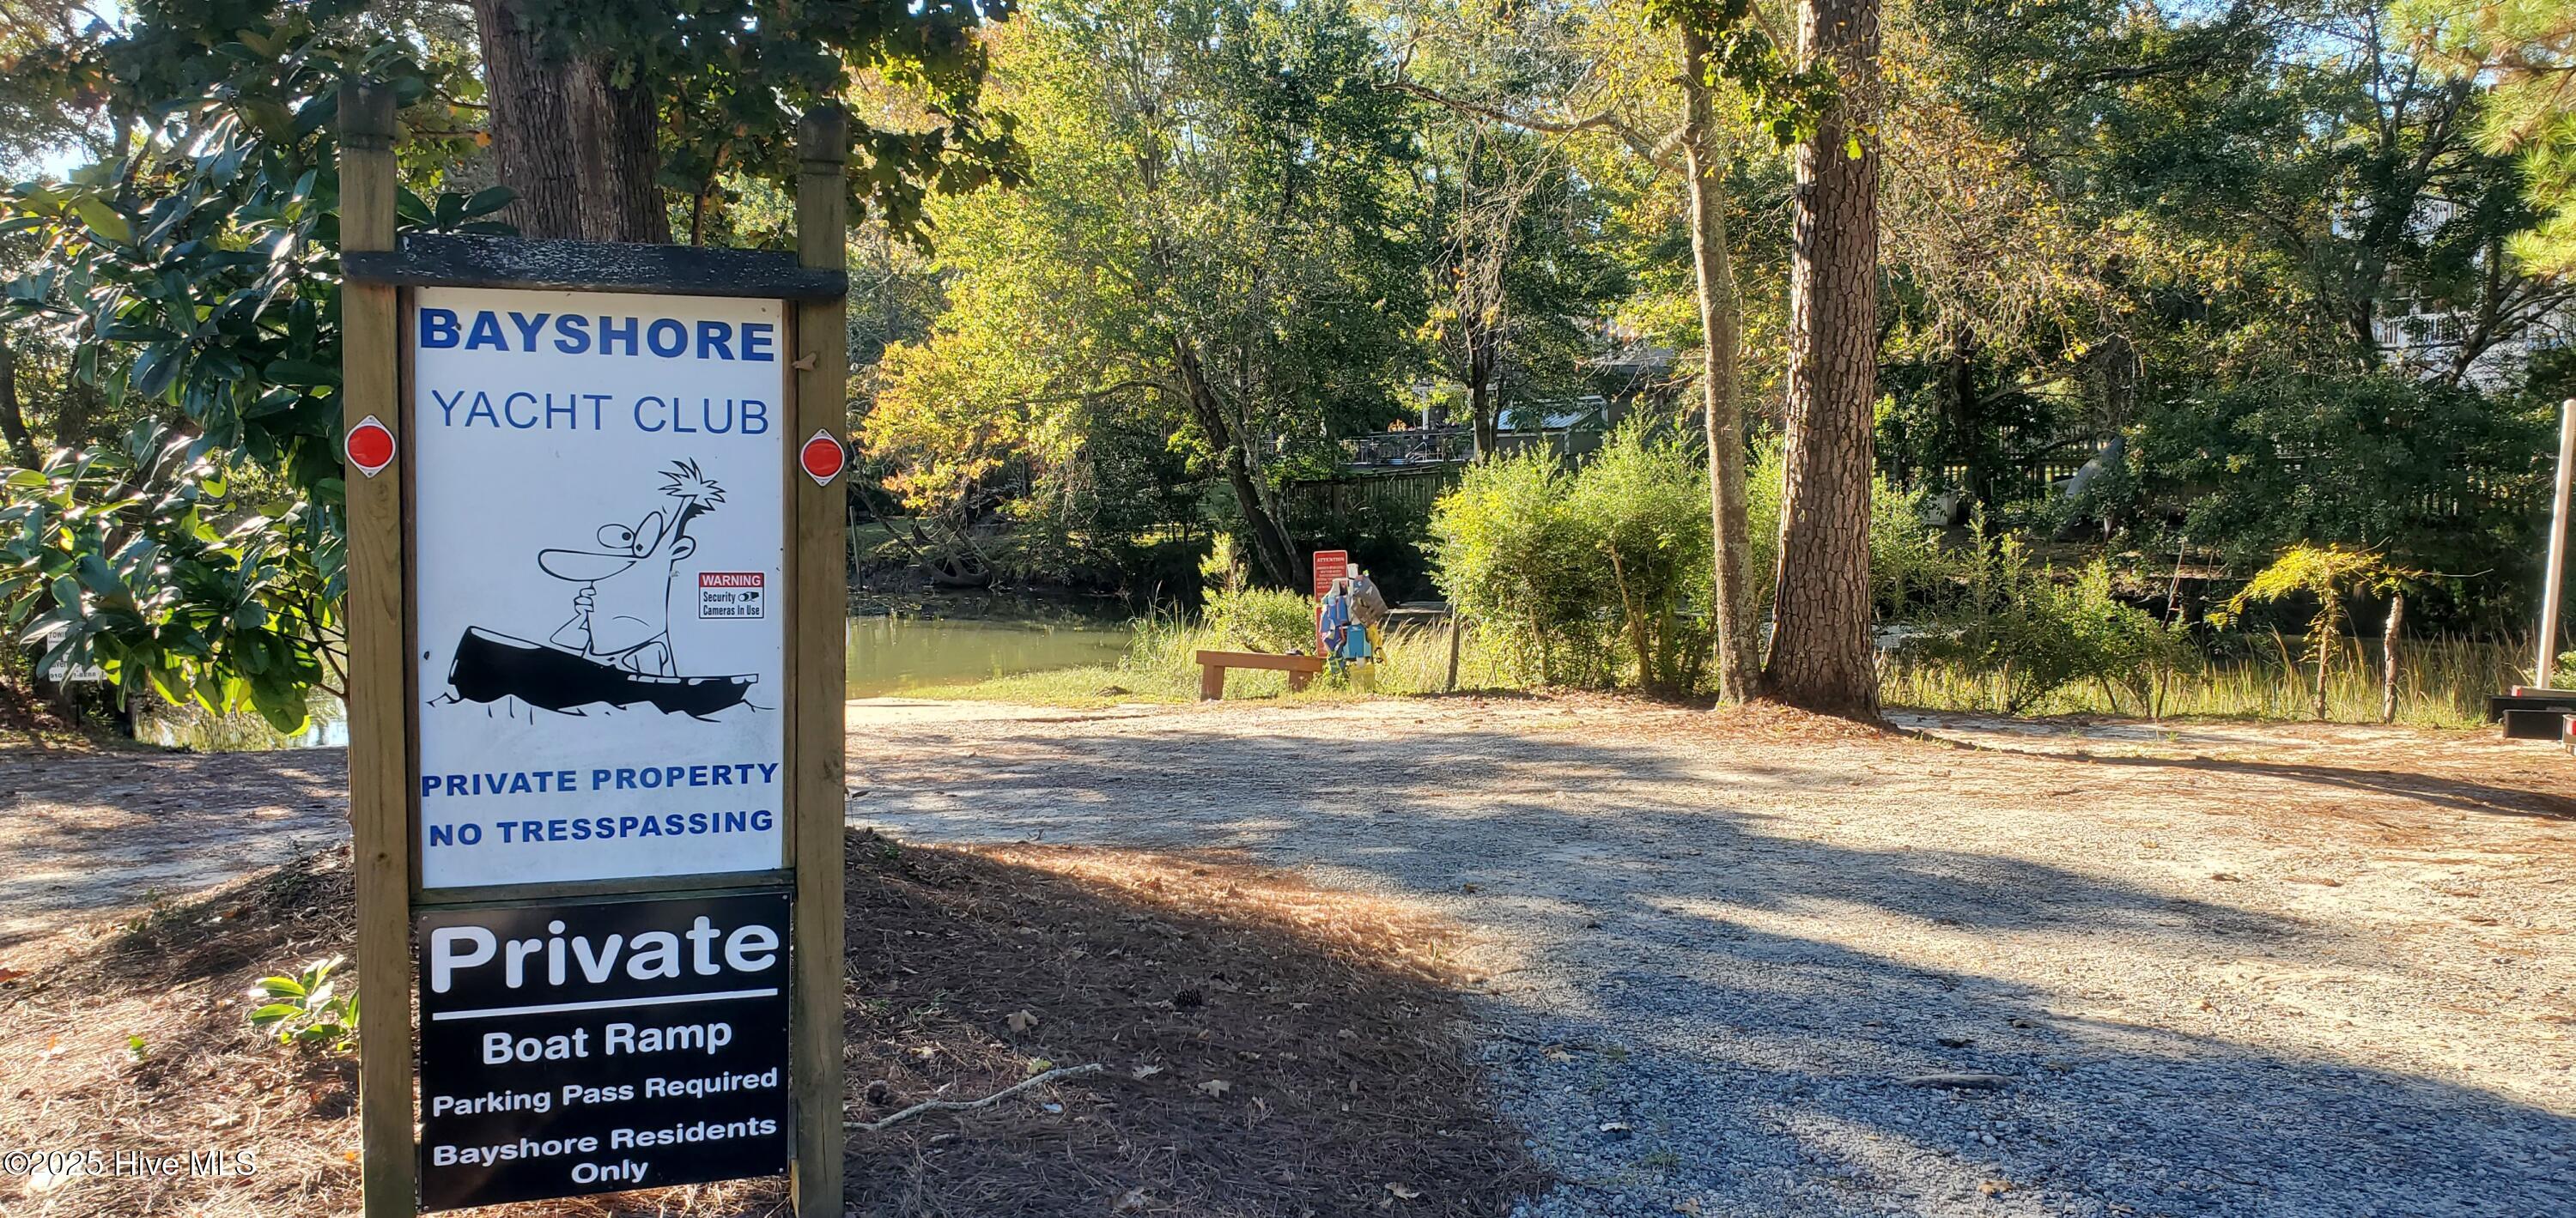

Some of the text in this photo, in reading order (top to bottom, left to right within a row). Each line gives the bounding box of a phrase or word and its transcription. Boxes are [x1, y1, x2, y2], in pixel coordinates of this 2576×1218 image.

[420, 307, 774, 361] BAYSHORE
[432, 391, 768, 434] YACHT CLUB
[702, 575, 761, 586] WARNING
[703, 591, 735, 603] Security
[703, 605, 759, 615] Cameras In Use
[422, 763, 779, 797] PRIVATE PROPERTY
[430, 810, 772, 846] NO TRESSPASSING
[432, 915, 778, 993] Private
[483, 1023, 732, 1064] Boat Ramp
[434, 1068, 776, 1117] Parking Pass Required
[434, 1118, 776, 1167] Bayshore Residents
[572, 1160, 647, 1183] Only
